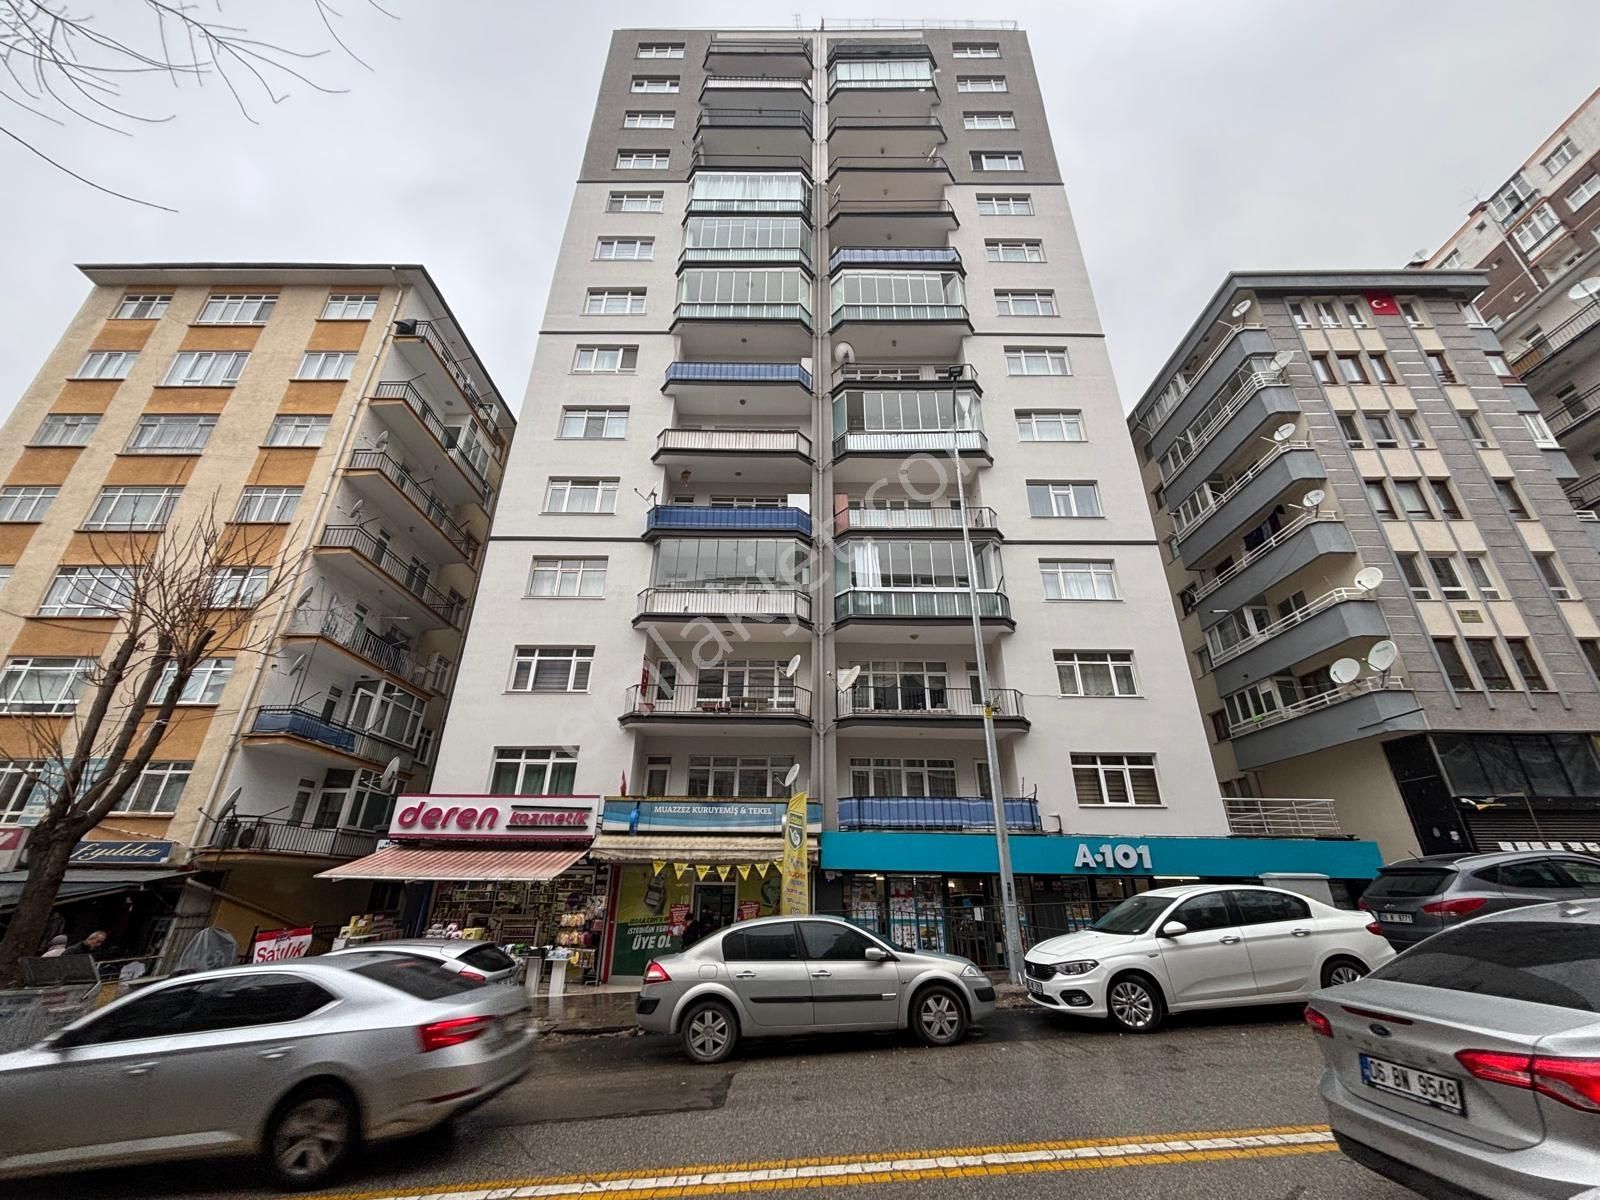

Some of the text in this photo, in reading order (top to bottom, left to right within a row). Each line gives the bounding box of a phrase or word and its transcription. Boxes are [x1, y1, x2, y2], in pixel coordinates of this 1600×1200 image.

[398, 801, 500, 830] deren
[654, 805, 691, 813] MUAZZEZ
[692, 806, 738, 816] KURUYEMİŞ
[748, 807, 773, 815] TEKEL
[631, 934, 672, 951] ÜYE OL
[1369, 1060, 1386, 1082] 06
[1418, 1074, 1459, 1105] 9548
